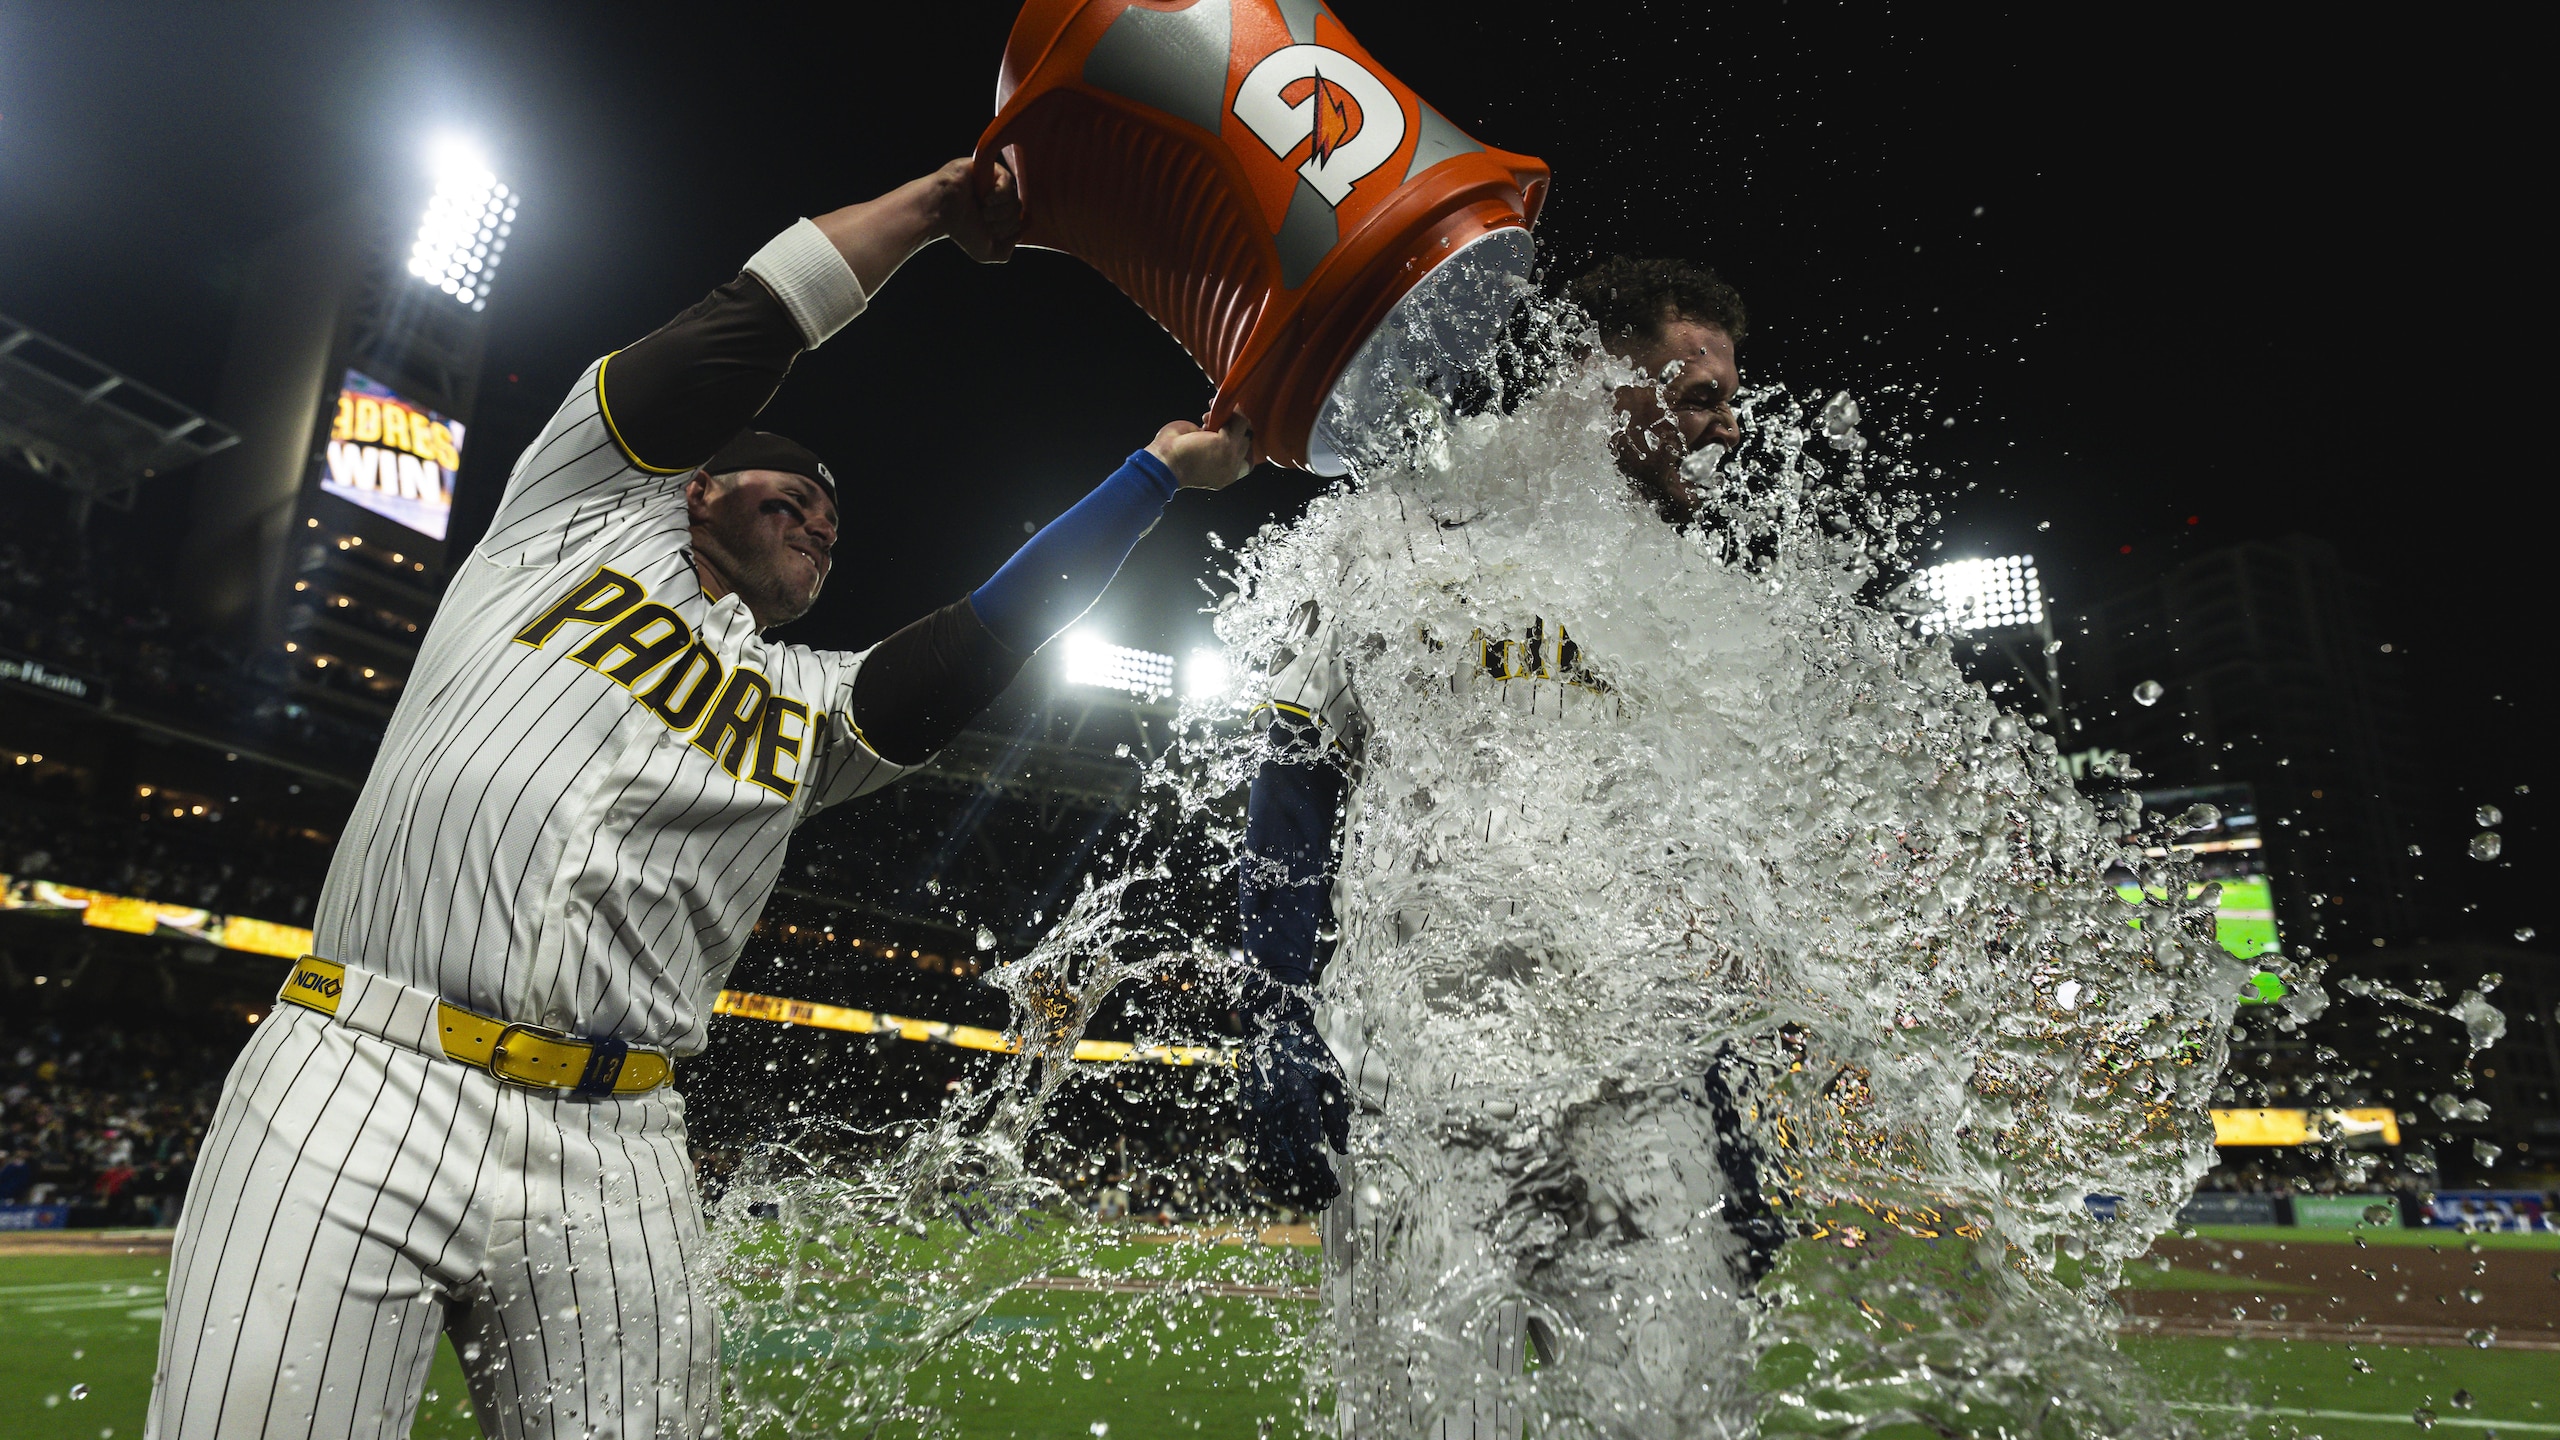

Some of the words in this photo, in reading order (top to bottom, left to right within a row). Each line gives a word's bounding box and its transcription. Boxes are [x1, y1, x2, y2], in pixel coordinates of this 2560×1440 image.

[1231, 43, 1407, 208] G
[327, 441, 442, 503] WIN
[511, 564, 828, 803] PADRE
[591, 1054, 620, 1084] 13
